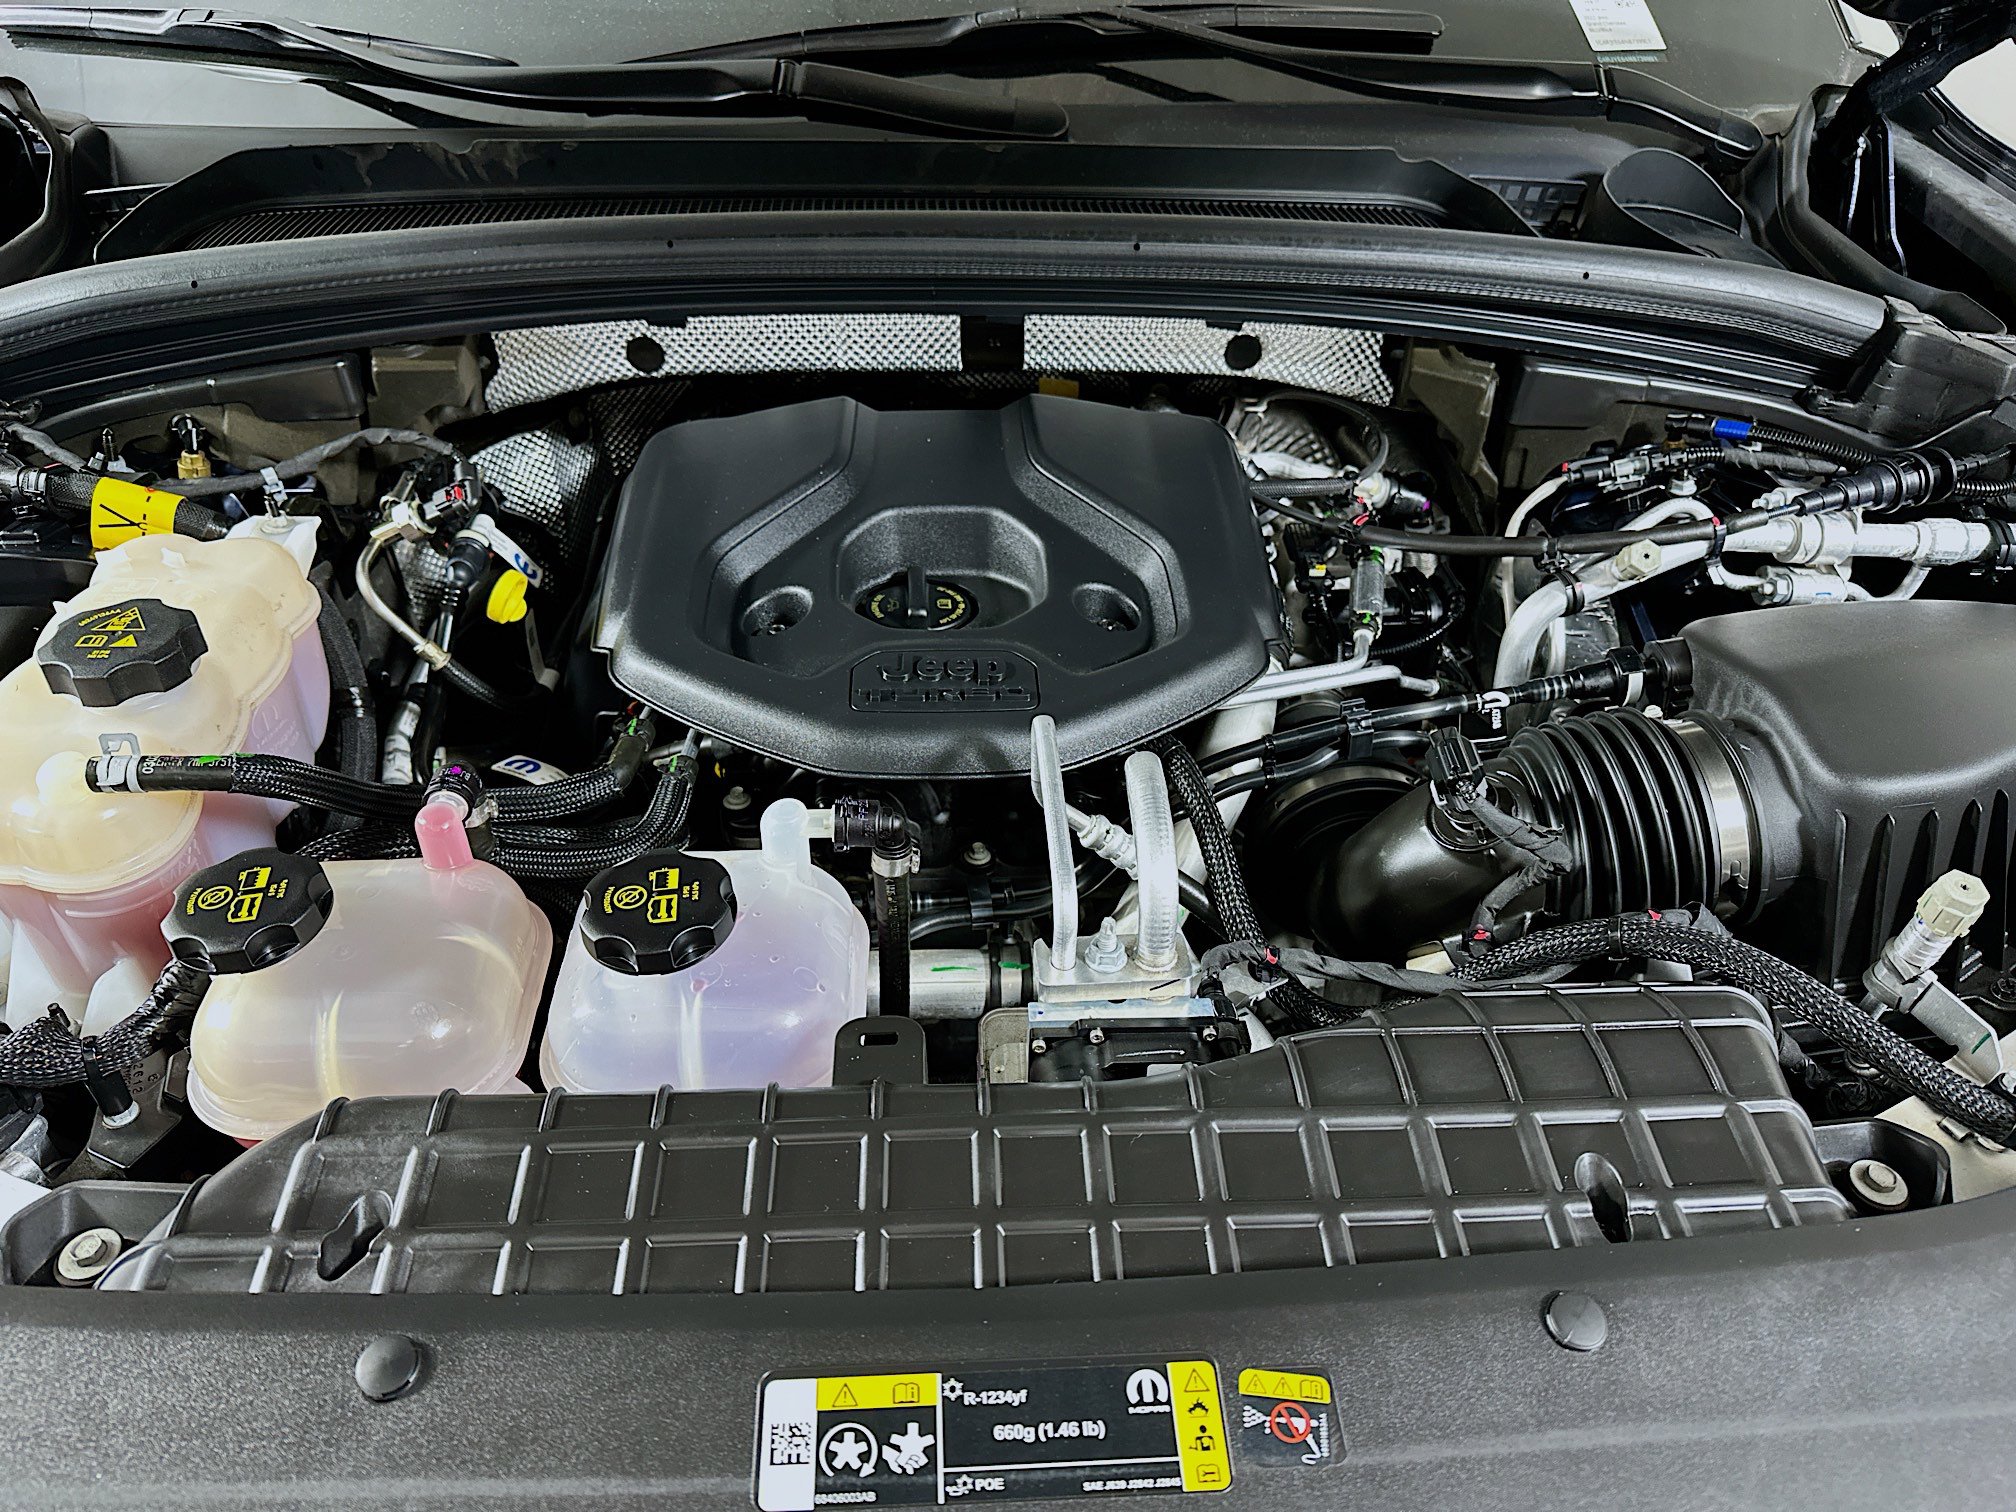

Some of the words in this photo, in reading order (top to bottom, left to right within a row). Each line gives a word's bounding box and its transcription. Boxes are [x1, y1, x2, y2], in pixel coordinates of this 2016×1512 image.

[882, 653, 1006, 686] Jeep
[963, 1389, 1029, 1406] R-1234yf
[993, 1423, 1036, 1443] 660g
[1038, 1421, 1081, 1442] (1.46
[1081, 1419, 1106, 1440] lb)
[975, 1477, 1006, 1491] POE
